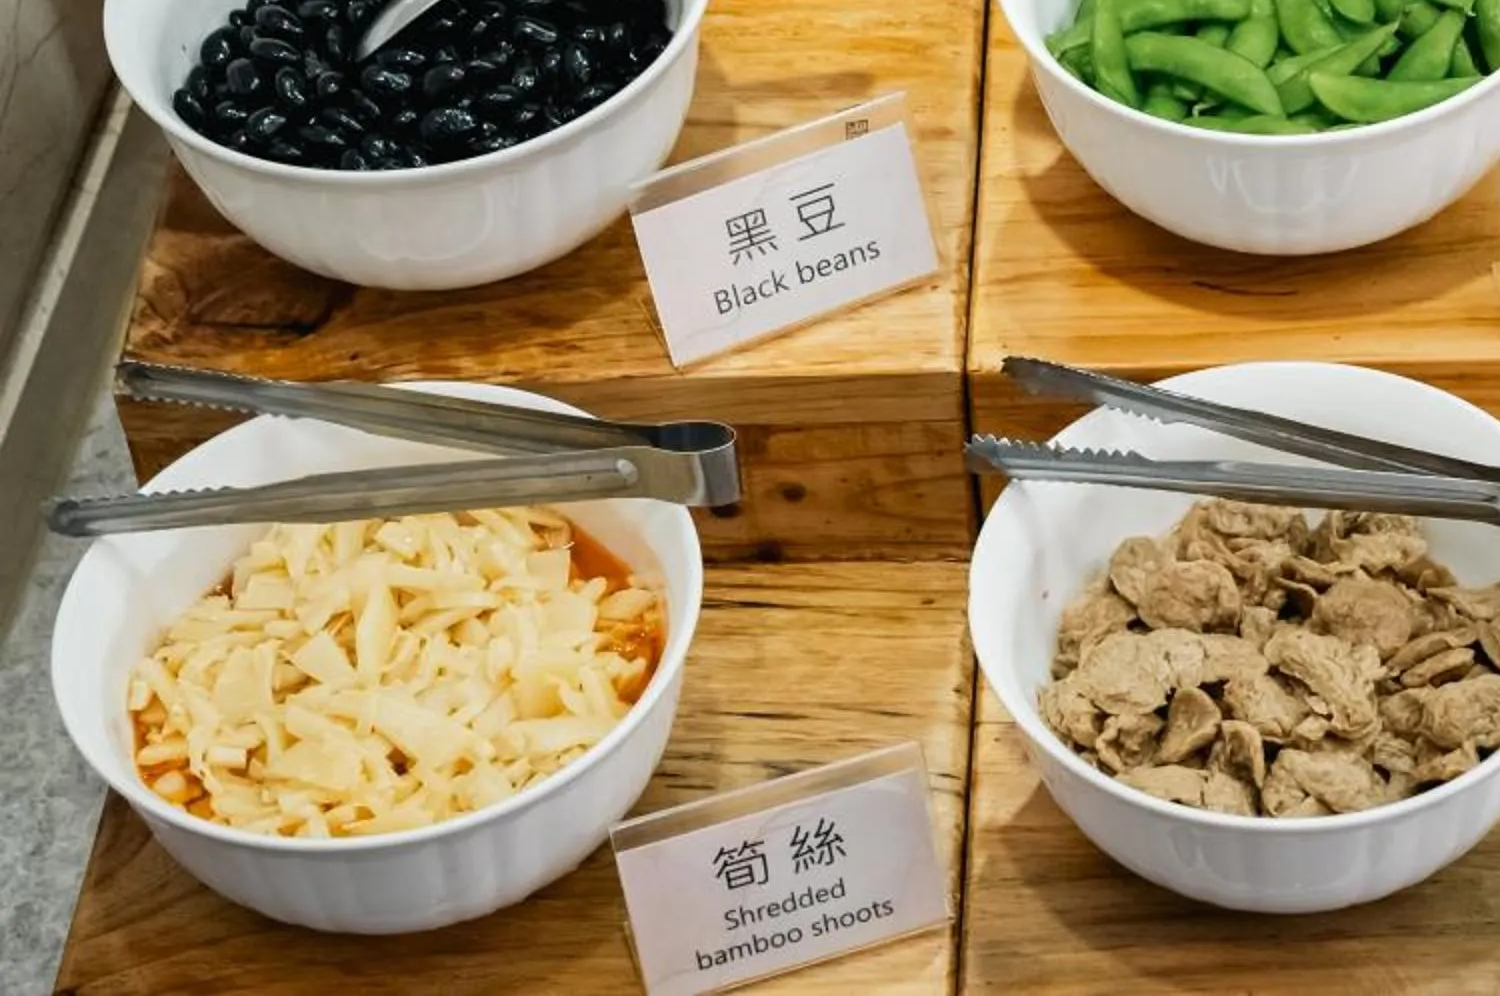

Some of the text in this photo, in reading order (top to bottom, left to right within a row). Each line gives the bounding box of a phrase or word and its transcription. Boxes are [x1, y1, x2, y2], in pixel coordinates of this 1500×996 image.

[725, 183, 846, 266] 黑豆
[714, 240, 881, 315] Black beans
[712, 817, 848, 891] 筍絲
[696, 898, 895, 971] bamboo shoots
[723, 877, 847, 931] Shredded
